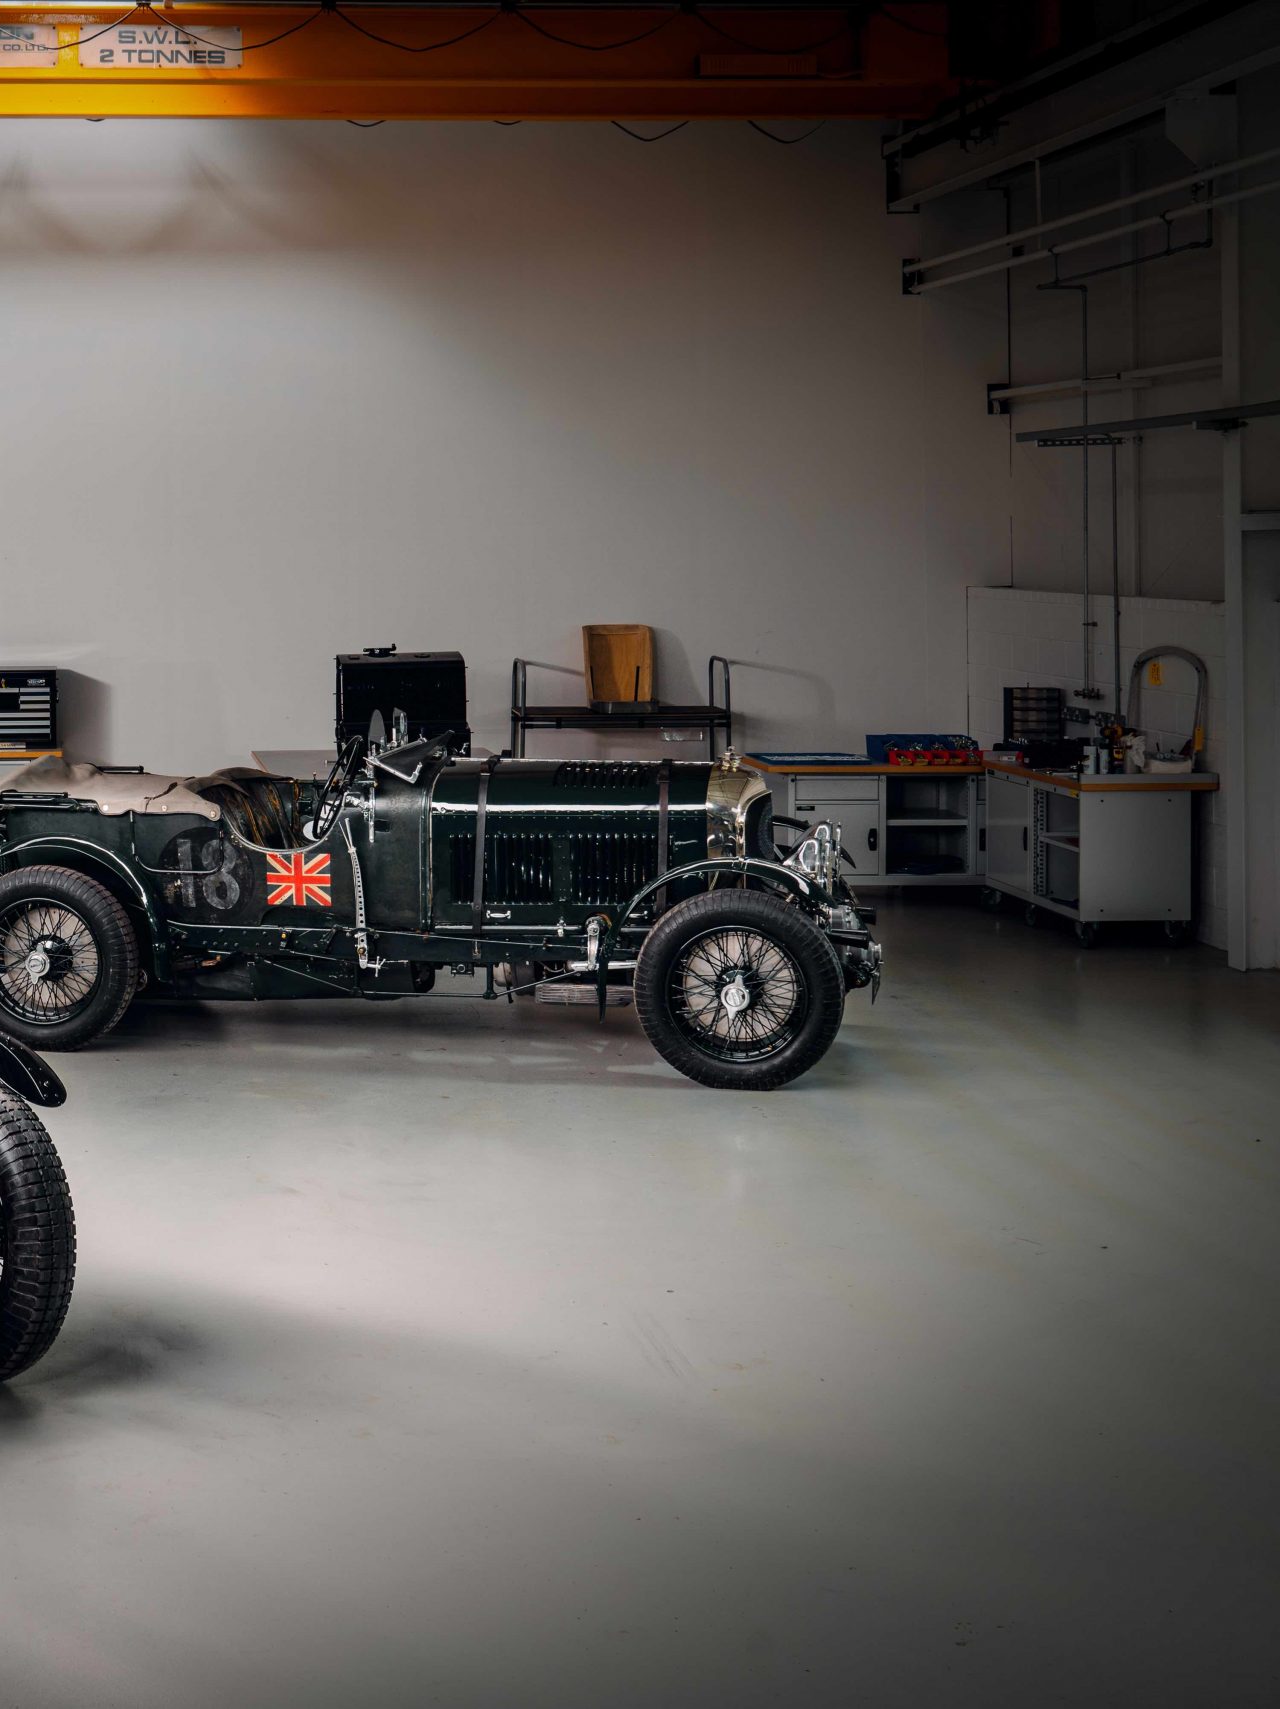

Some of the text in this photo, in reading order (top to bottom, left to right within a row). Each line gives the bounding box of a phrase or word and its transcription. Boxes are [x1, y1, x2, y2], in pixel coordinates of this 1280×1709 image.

[118, 30, 198, 45] S.W.L.
[100, 49, 225, 64] 2 TONNES
[176, 839, 240, 909] 18
